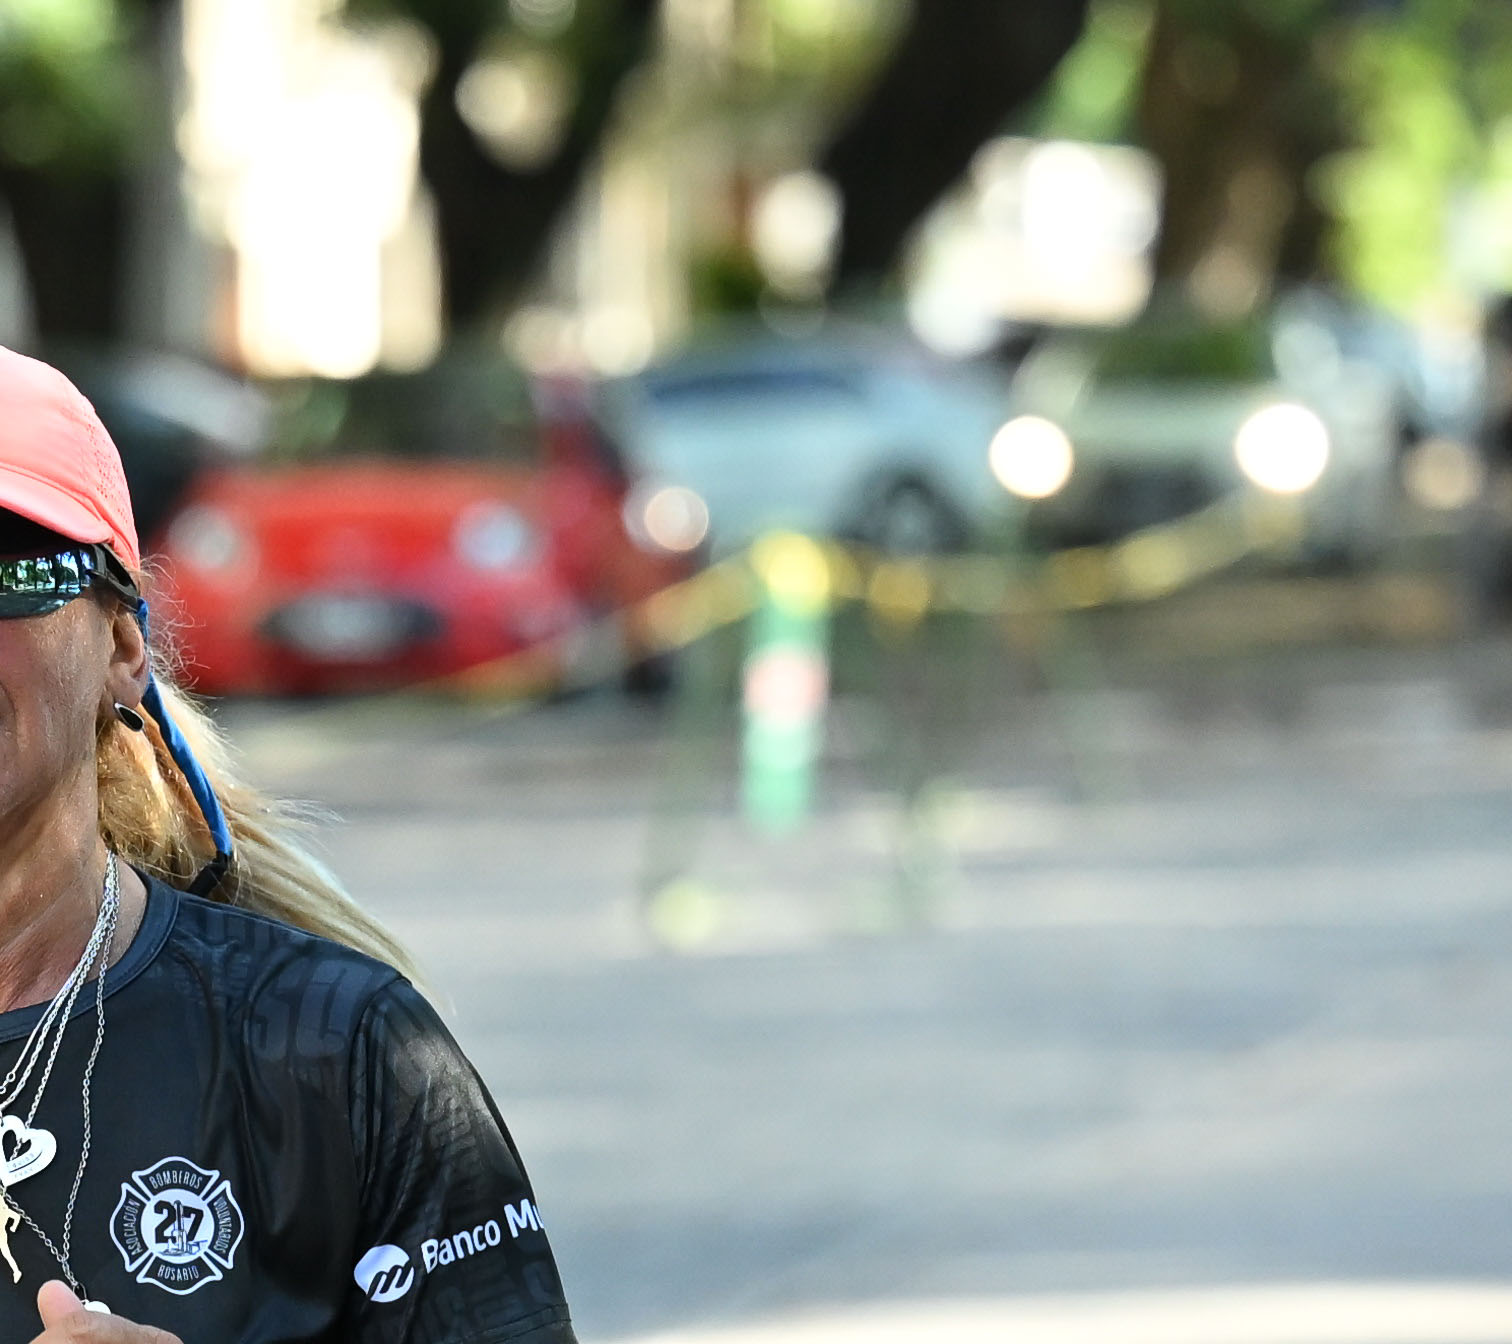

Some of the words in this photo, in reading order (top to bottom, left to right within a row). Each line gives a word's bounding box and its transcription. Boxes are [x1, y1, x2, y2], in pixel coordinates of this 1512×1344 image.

[148, 1169, 203, 1190] BOMBEROS
[153, 1199, 204, 1244] 27
[420, 1219, 501, 1274] Banco
[157, 1264, 199, 1282] ROSARIO
